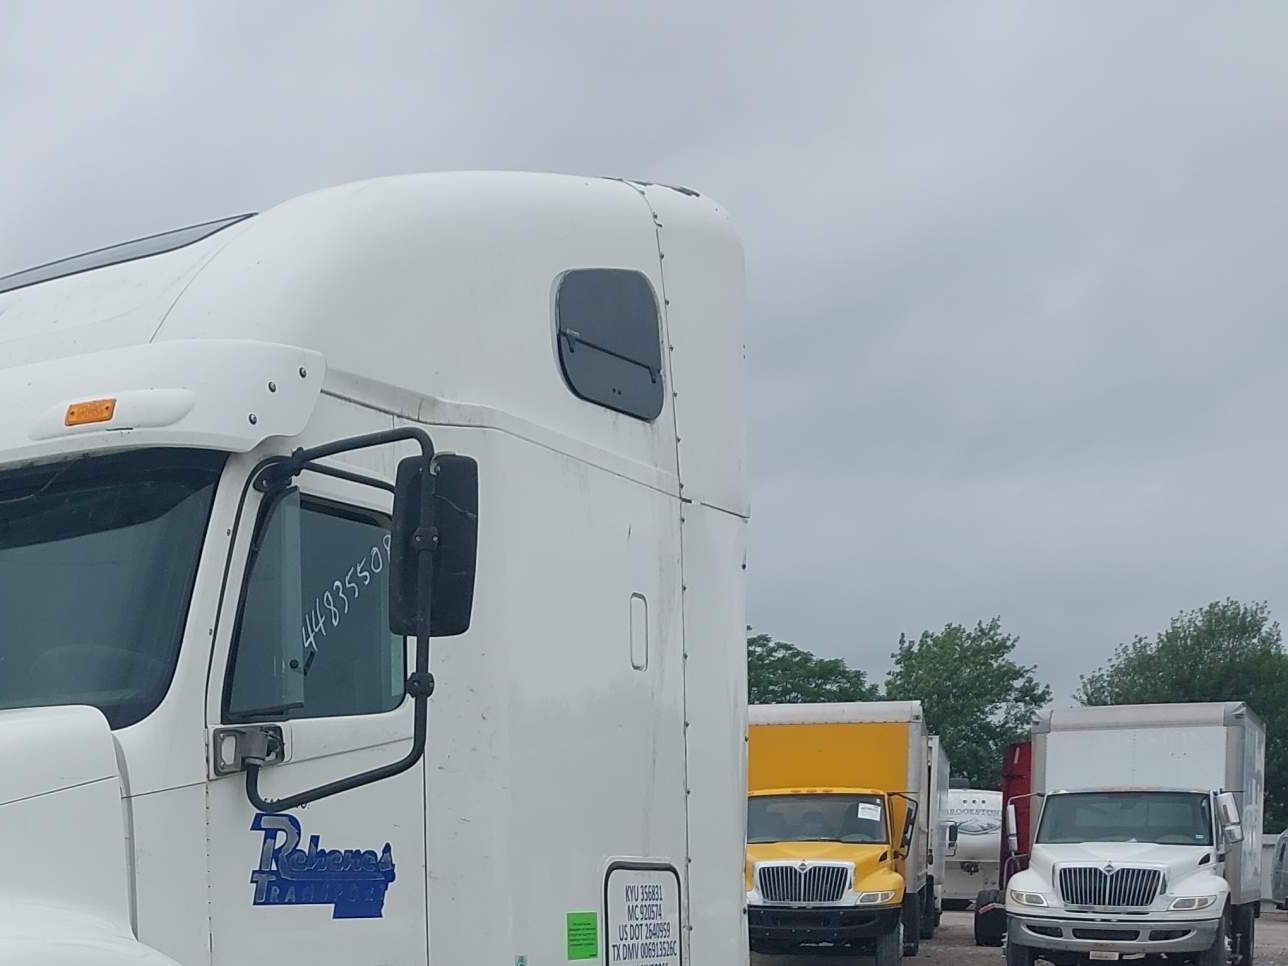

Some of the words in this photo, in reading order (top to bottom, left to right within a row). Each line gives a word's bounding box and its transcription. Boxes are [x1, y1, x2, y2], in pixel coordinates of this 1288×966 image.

[625, 885, 639, 902] KYU
[627, 904, 639, 921] MC
[619, 923, 628, 942] US
[630, 923, 643, 941] DOT
[612, 944, 621, 961] TX
[622, 943, 639, 960] DMV
